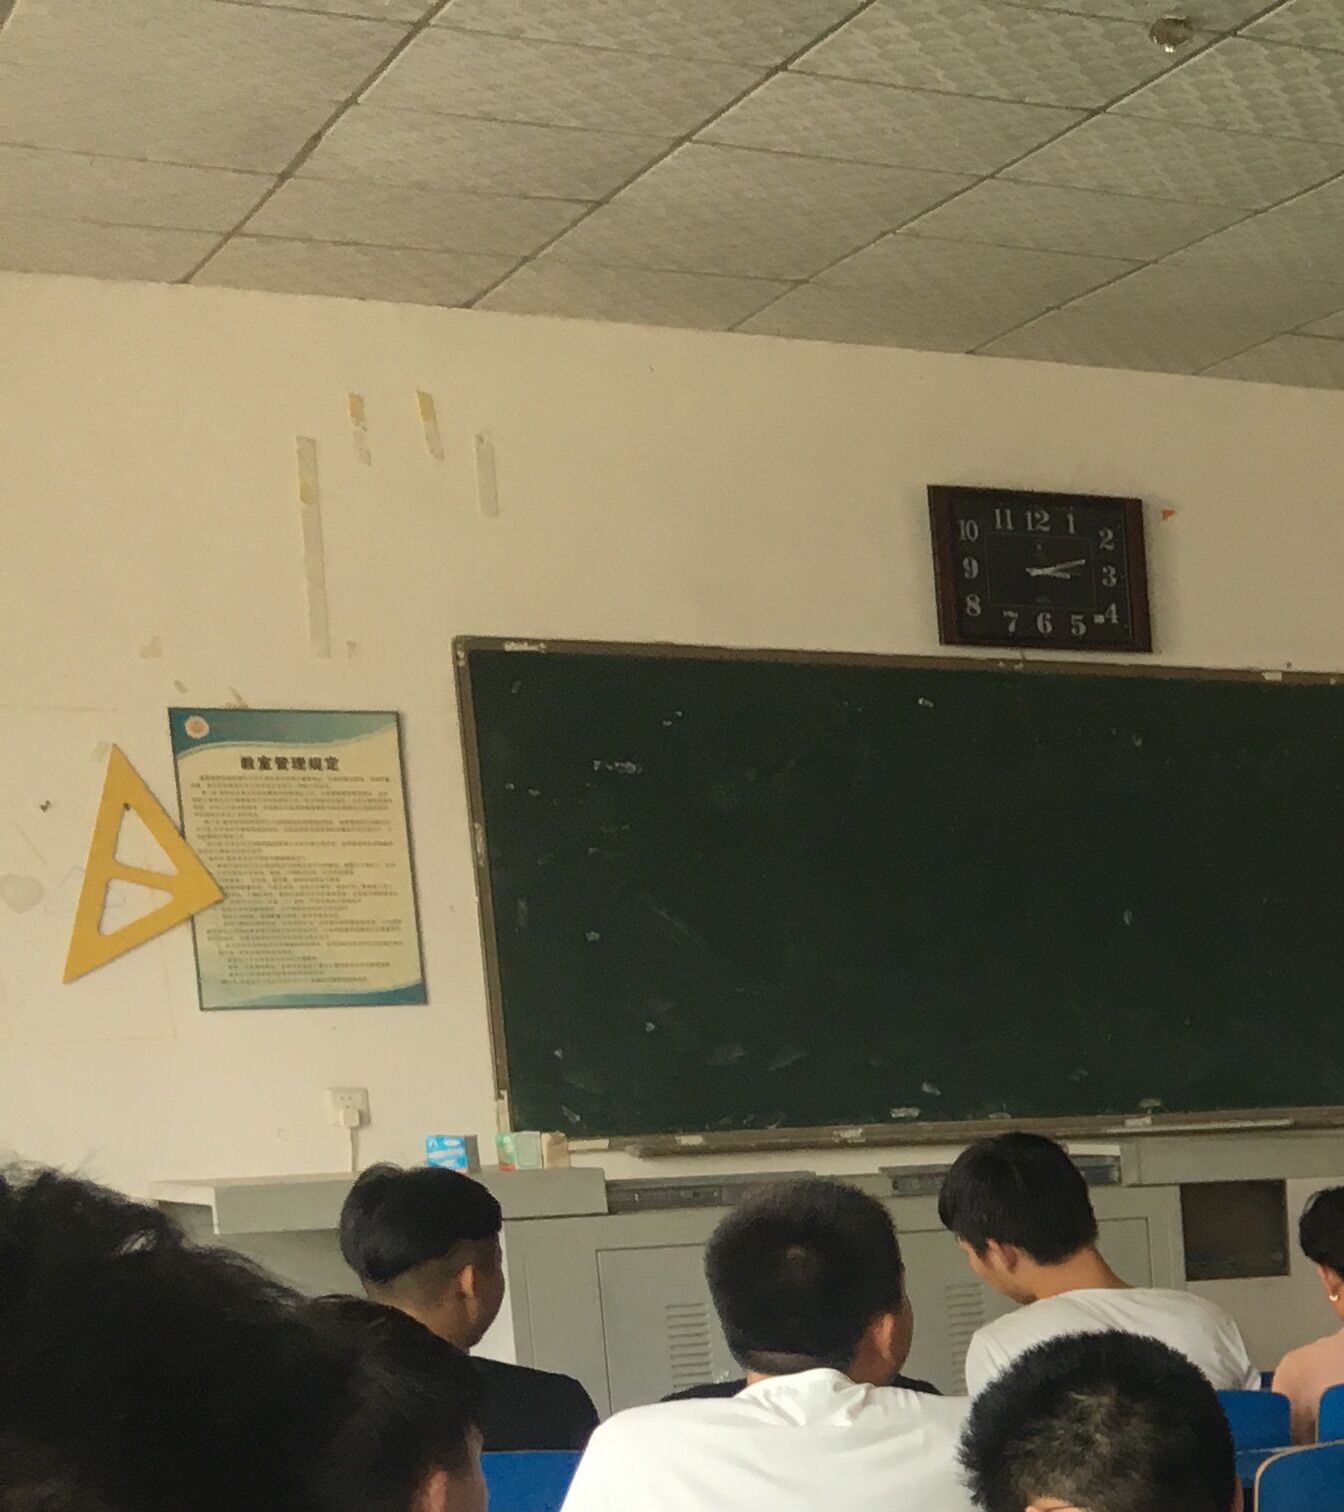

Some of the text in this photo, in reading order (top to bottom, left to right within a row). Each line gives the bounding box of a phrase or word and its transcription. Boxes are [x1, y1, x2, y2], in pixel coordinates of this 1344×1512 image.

[959, 519, 979, 543] 10
[995, 508, 1076, 534] 11 12 1
[1099, 528, 1114, 551] 2
[963, 557, 979, 579] 9
[1102, 565, 1117, 587] 3
[966, 594, 981, 616] 8
[1103, 602, 1119, 624] 4
[1003, 610, 1087, 636] 7 6 5
[240, 755, 339, 771] 教室管理规定
